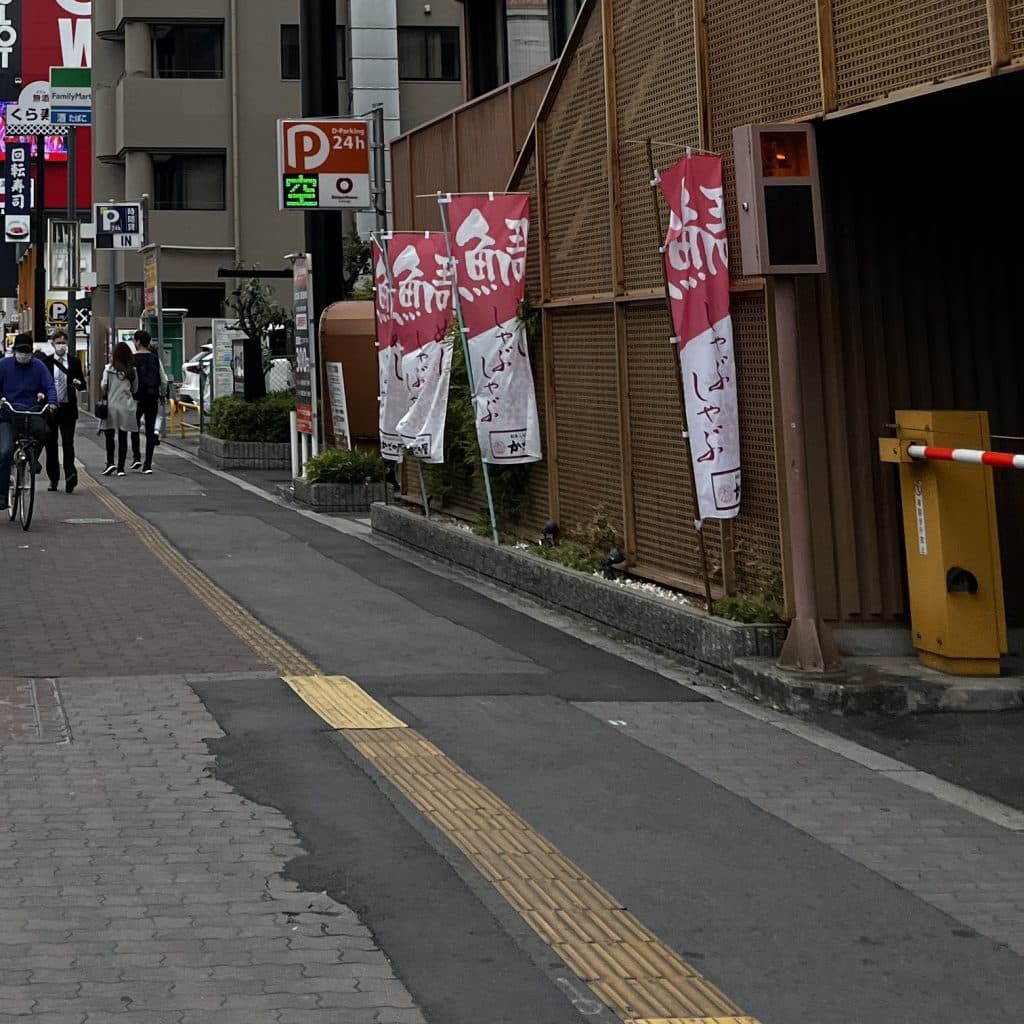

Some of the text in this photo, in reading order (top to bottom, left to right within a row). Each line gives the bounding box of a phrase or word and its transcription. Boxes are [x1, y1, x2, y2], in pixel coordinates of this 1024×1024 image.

[332, 136, 365, 149] 24h
[10, 147, 26, 209] 回転寿司
[121, 236, 132, 246] IN
